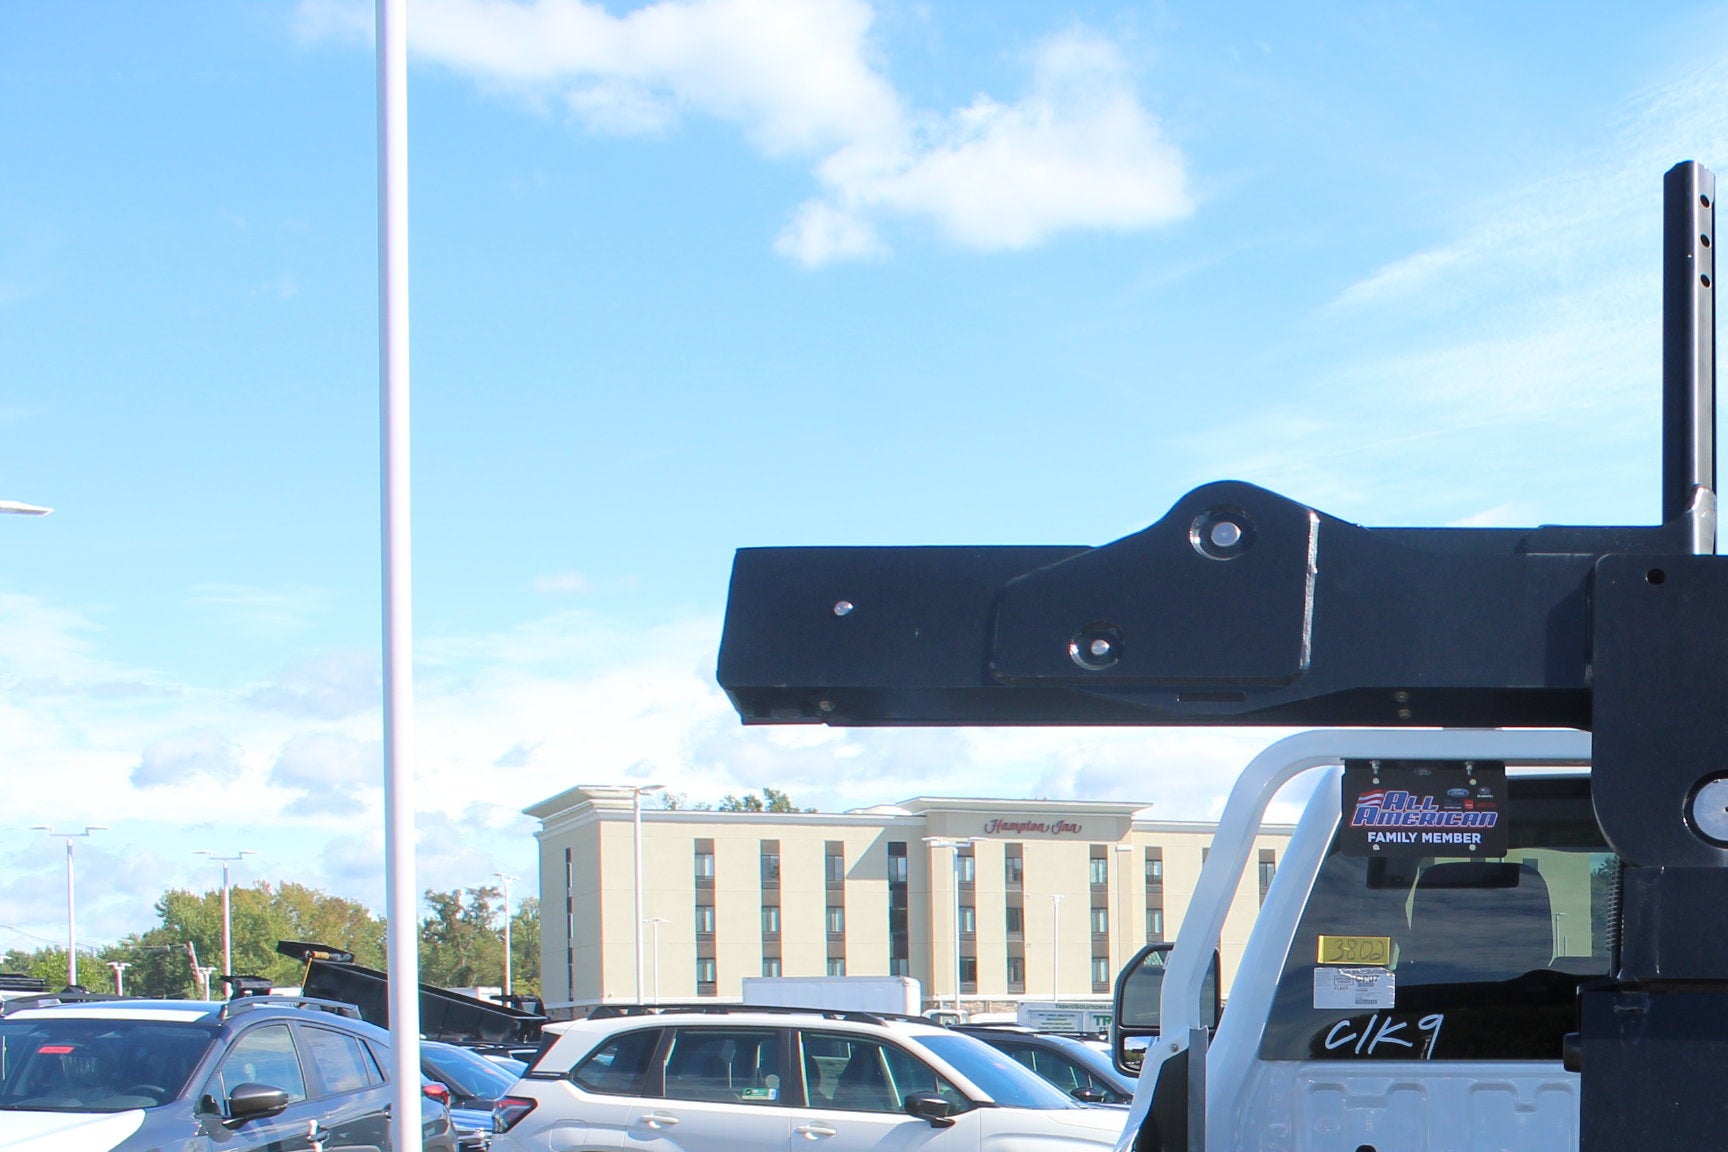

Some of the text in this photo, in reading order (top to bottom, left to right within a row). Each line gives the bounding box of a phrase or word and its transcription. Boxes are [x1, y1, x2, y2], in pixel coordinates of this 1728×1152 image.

[1380, 790, 1439, 811] ALL
[1351, 806, 1498, 827] AMERICAN
[985, 819, 1082, 835] Hampton Inn
[1367, 831, 1481, 844] FAMILY MEMBER
